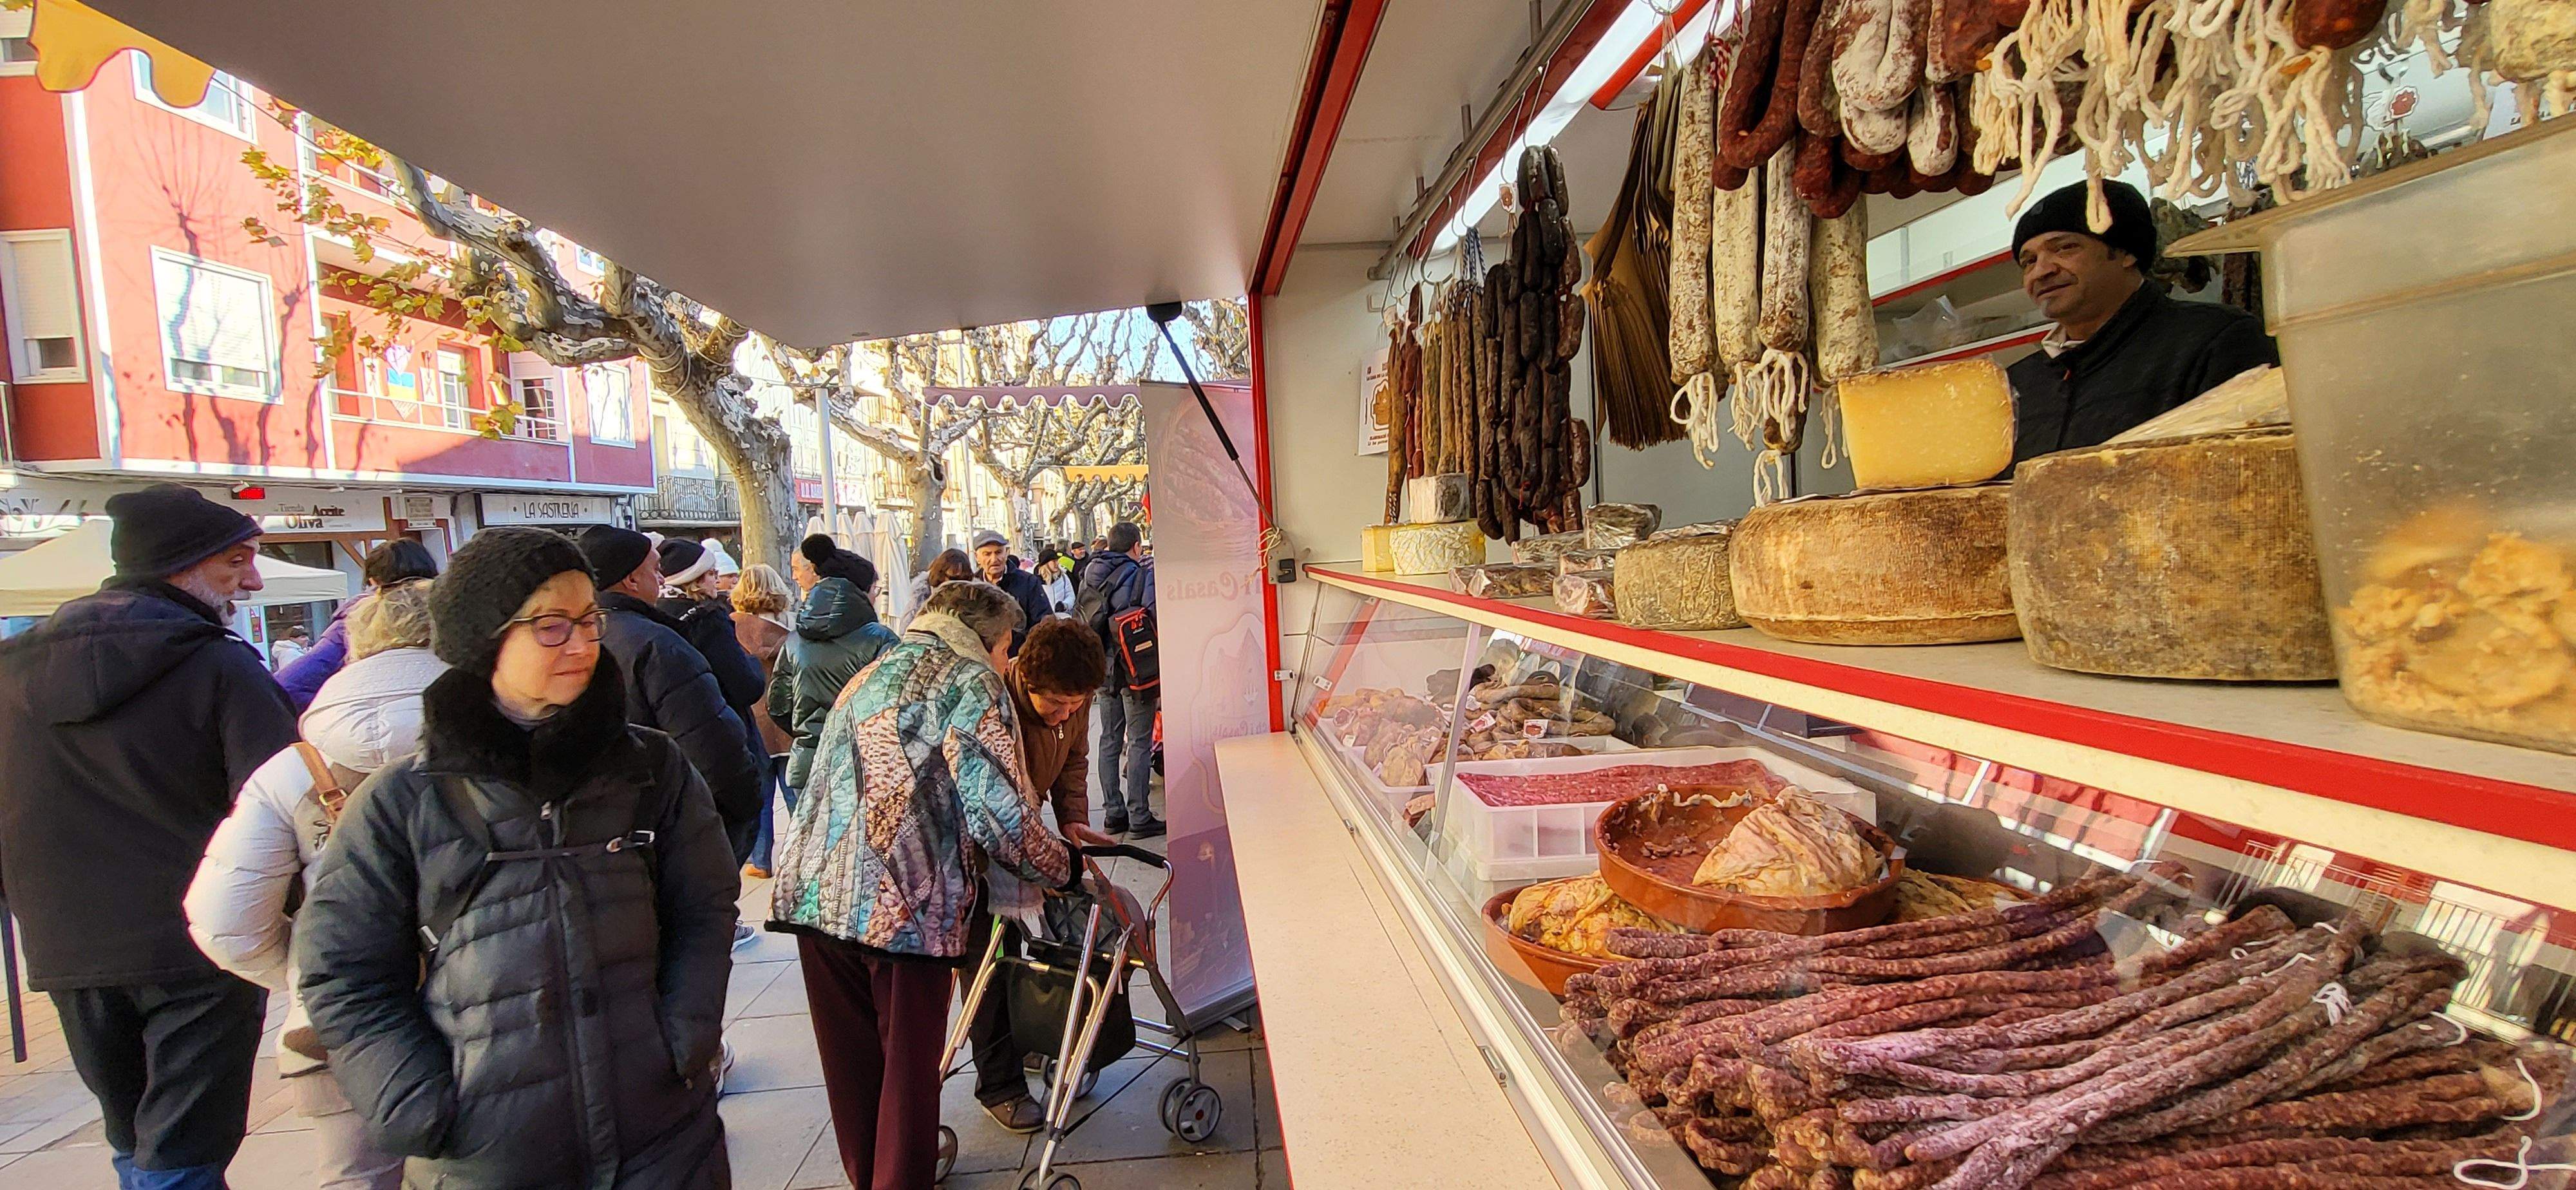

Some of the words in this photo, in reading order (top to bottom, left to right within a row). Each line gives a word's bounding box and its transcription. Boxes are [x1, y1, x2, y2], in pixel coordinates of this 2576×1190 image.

[312, 504, 345, 516] Aceite
[523, 502, 536, 518] LA
[285, 513, 324, 529] Oliva
